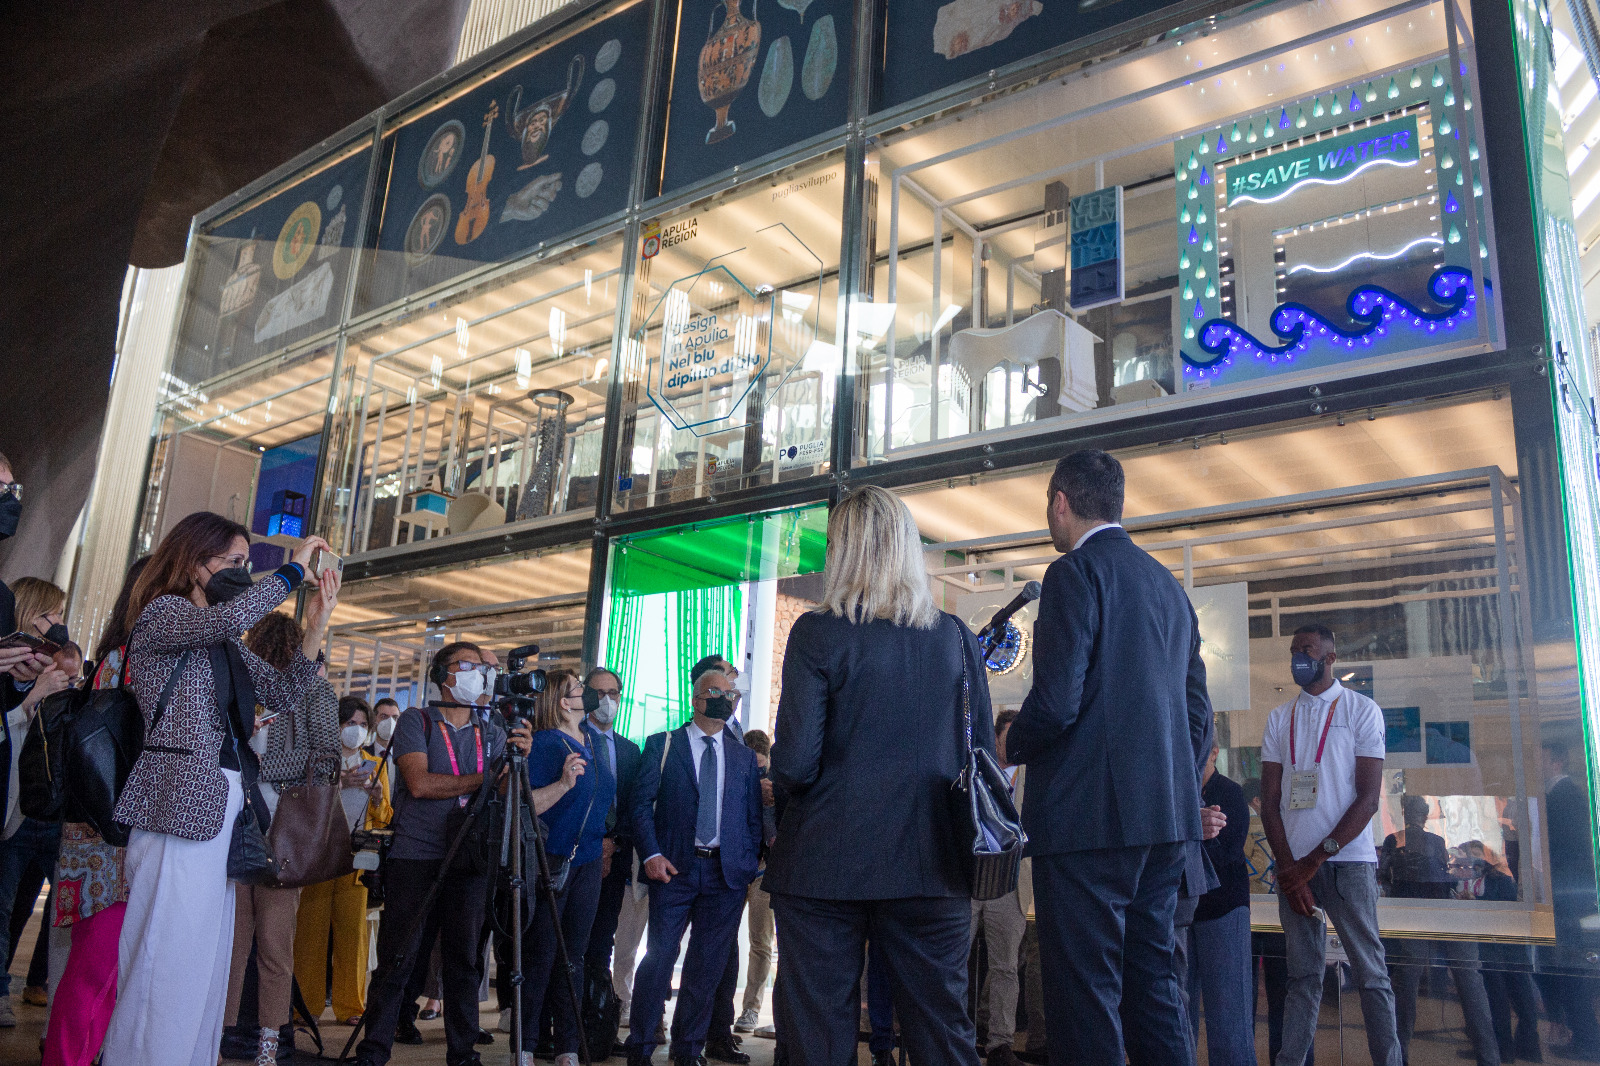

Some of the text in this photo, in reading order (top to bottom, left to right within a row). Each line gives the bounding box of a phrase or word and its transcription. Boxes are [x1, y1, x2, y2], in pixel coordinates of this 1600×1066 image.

[1232, 130, 1411, 195] #SAVE WATER
[771, 171, 837, 202] pugliasviluppo
[661, 227, 698, 250] REGION
[662, 217, 698, 238] APULIA
[673, 315, 717, 337] Design
[685, 326, 729, 351] Apulia
[669, 349, 715, 372] Nel blu
[720, 356, 734, 374] di
